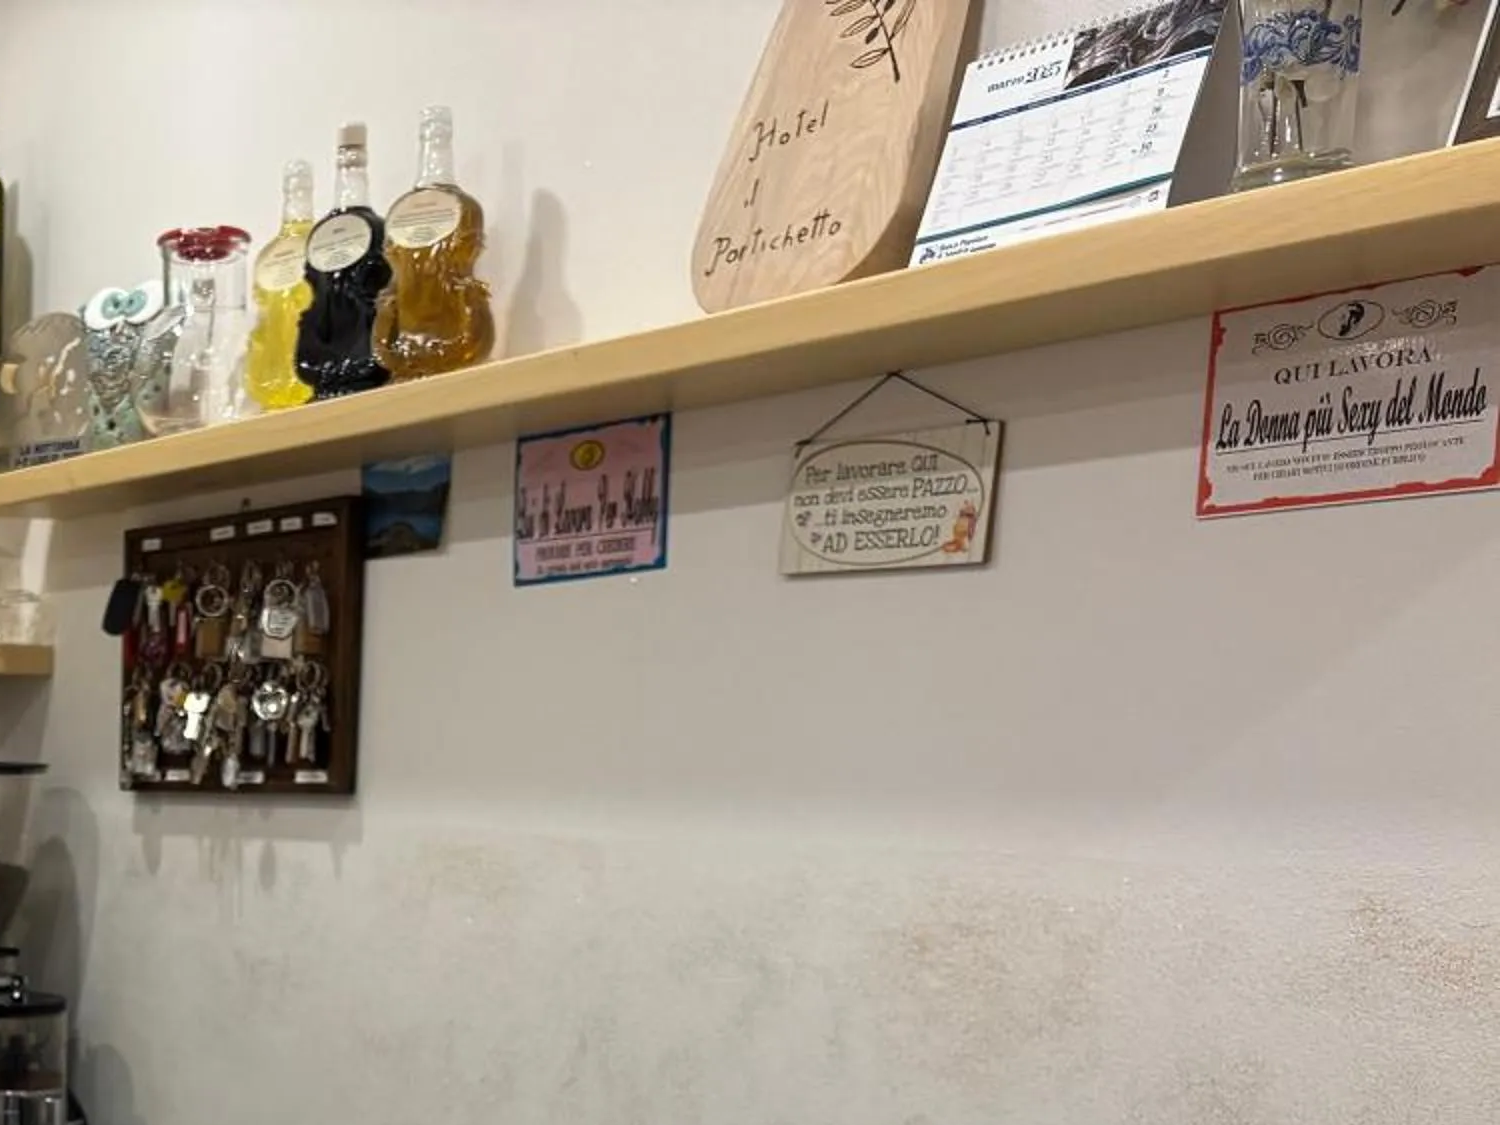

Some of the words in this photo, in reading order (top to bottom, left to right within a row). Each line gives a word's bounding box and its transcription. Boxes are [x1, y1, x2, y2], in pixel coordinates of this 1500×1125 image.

[748, 100, 829, 162] Hotel
[704, 208, 843, 277] Portichetto
[1273, 366, 1320, 385] QUI
[1329, 345, 1433, 378] LAVORA
[1216, 402, 1241, 449] La
[1244, 398, 1299, 447] Donna
[1303, 392, 1333, 454] più
[1337, 385, 1384, 445] Sexy
[1386, 374, 1414, 427] del
[1418, 367, 1488, 425] Mondo
[806, 465, 831, 483] Per
[836, 459, 908, 481] lavorare
[911, 454, 938, 473] QUI
[794, 493, 819, 507] non
[825, 486, 853, 505] devi
[857, 484, 909, 501] essere
[842, 505, 948, 527] insegneremo
[823, 532, 848, 553] AD
[854, 524, 940, 551] ESSERLO!
